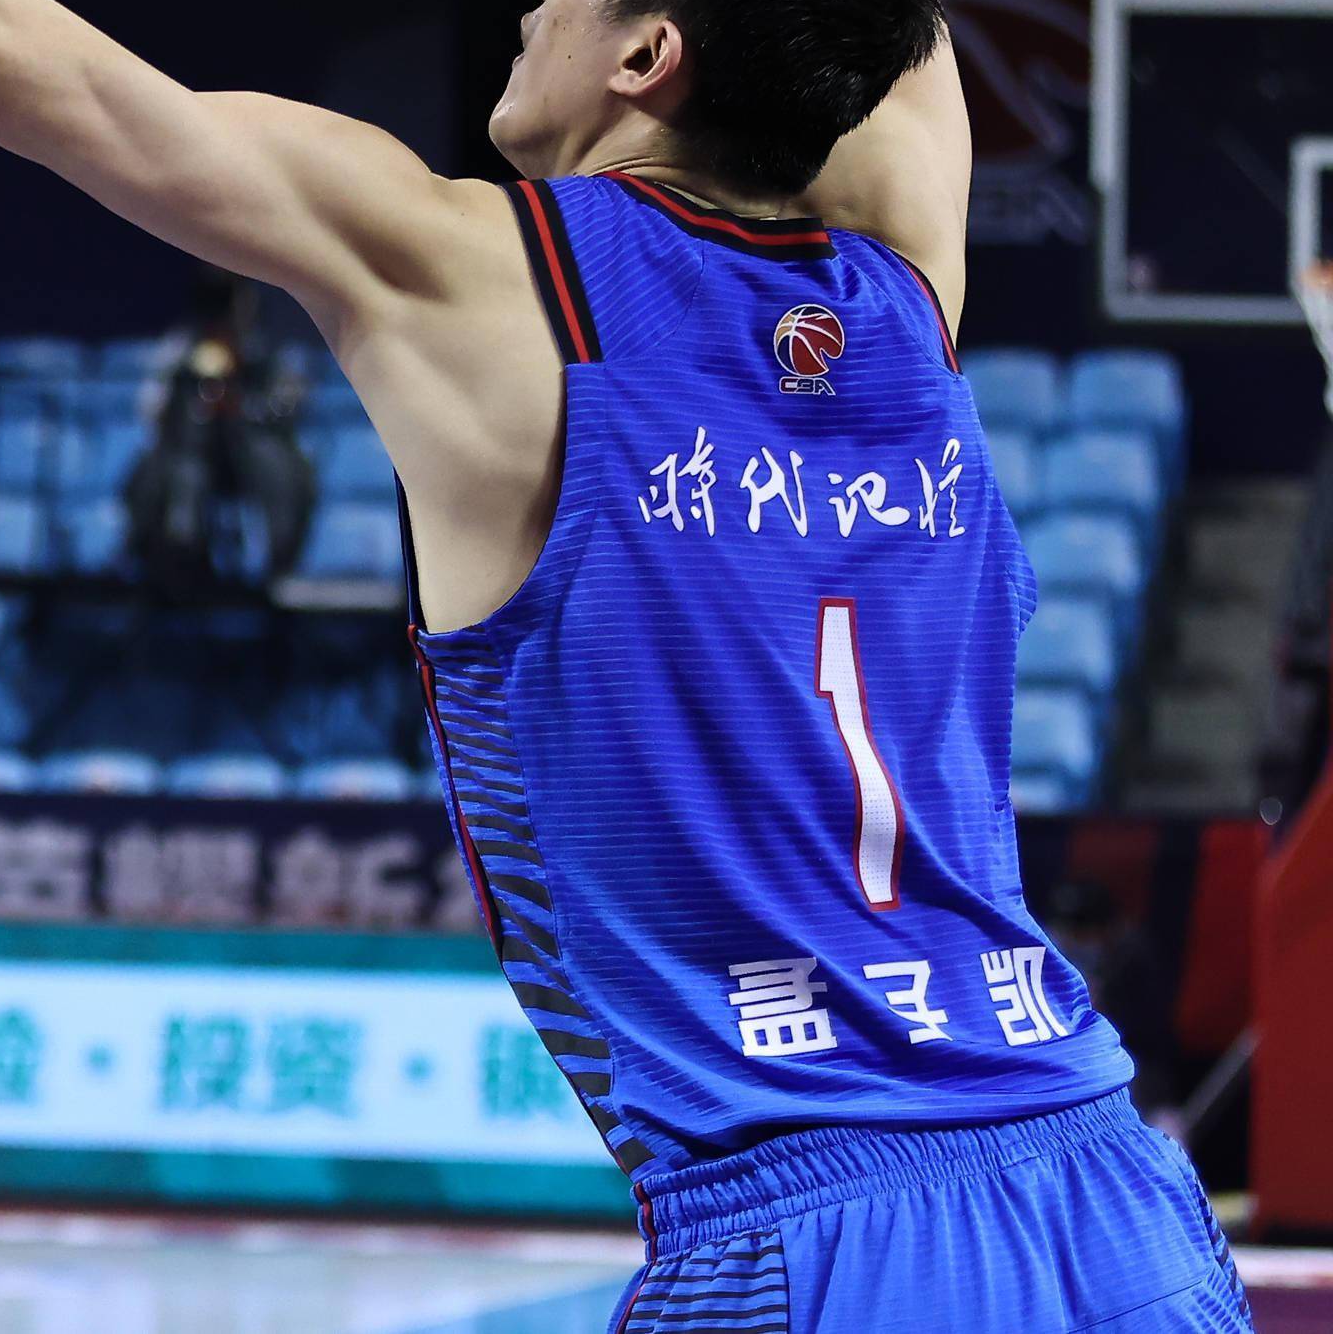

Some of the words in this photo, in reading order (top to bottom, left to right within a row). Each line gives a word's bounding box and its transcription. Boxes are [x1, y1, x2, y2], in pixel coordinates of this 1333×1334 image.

[779, 376, 836, 396] CBA
[814, 597, 906, 912] 1
[728, 946, 1069, 1059] 孟子凯
